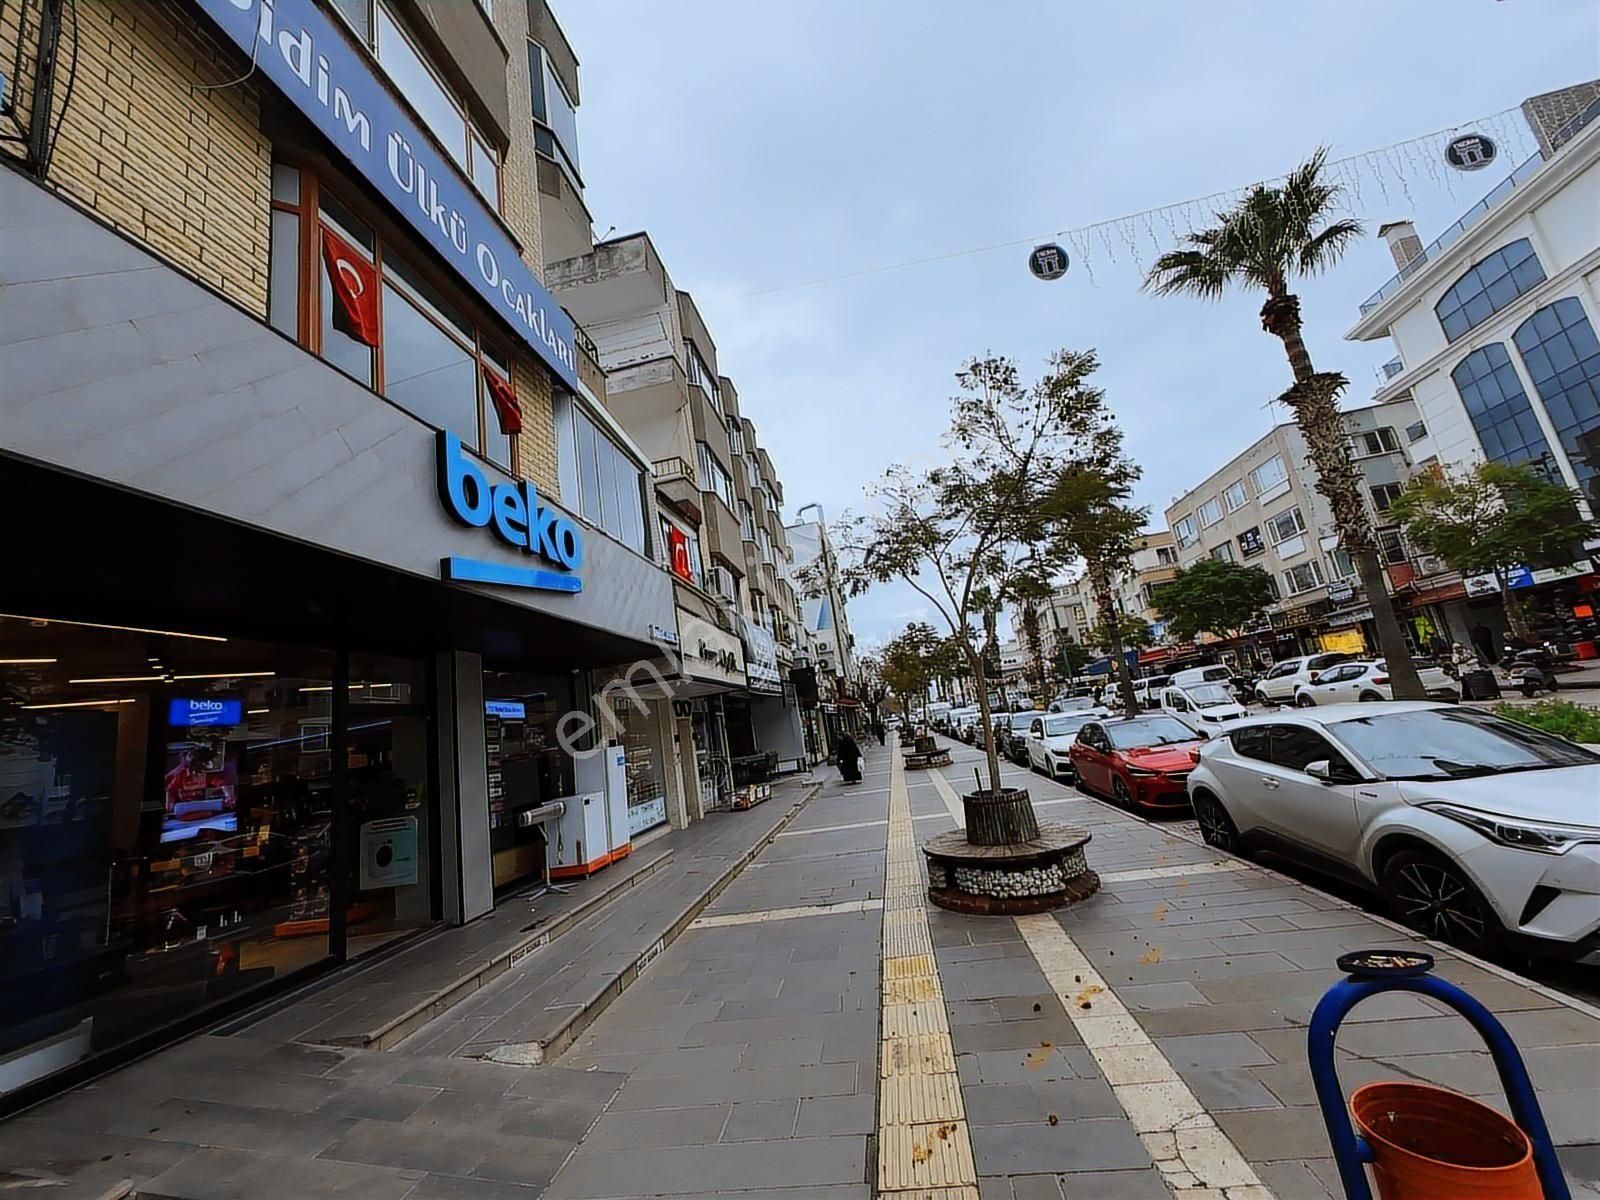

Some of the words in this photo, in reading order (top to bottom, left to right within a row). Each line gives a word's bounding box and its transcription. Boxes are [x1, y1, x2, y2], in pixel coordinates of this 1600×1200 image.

[229, 0, 371, 152] idim
[387, 130, 467, 255] Ülkü
[437, 430, 582, 571] beko
[189, 699, 223, 711] beko
